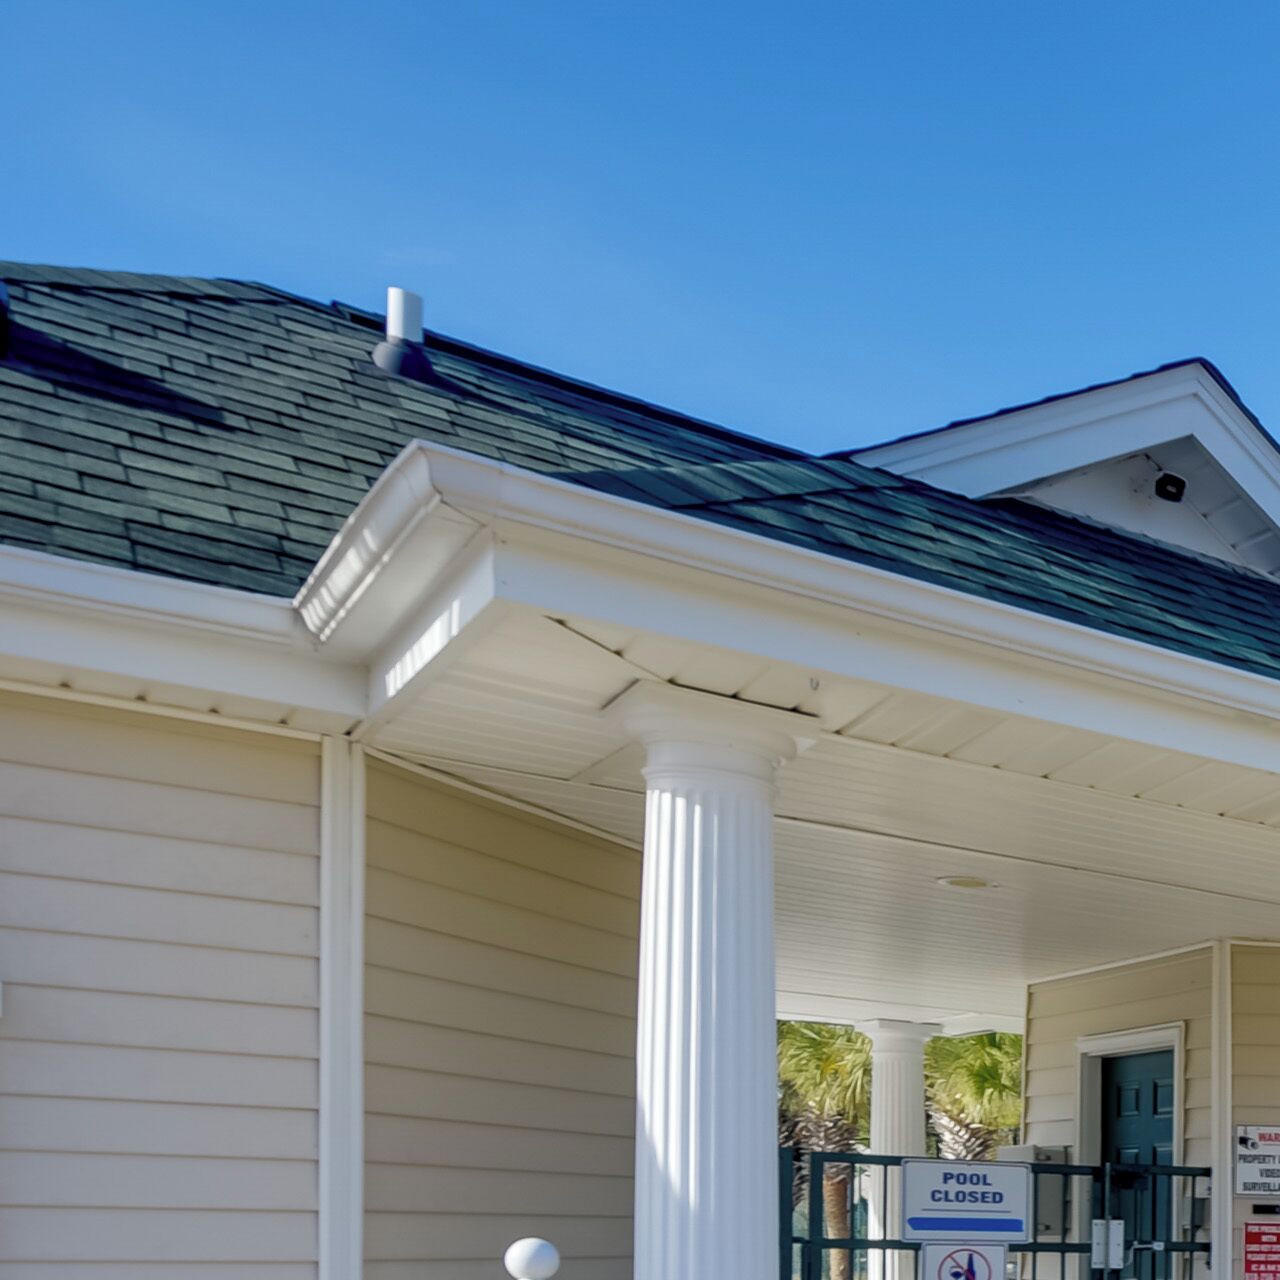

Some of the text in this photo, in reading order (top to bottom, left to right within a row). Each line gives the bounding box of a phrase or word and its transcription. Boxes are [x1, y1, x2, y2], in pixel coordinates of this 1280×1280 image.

[1238, 1154, 1276, 1165] PROPERTY
[943, 1172, 992, 1186] POOL
[931, 1189, 1004, 1204] CLOSED
